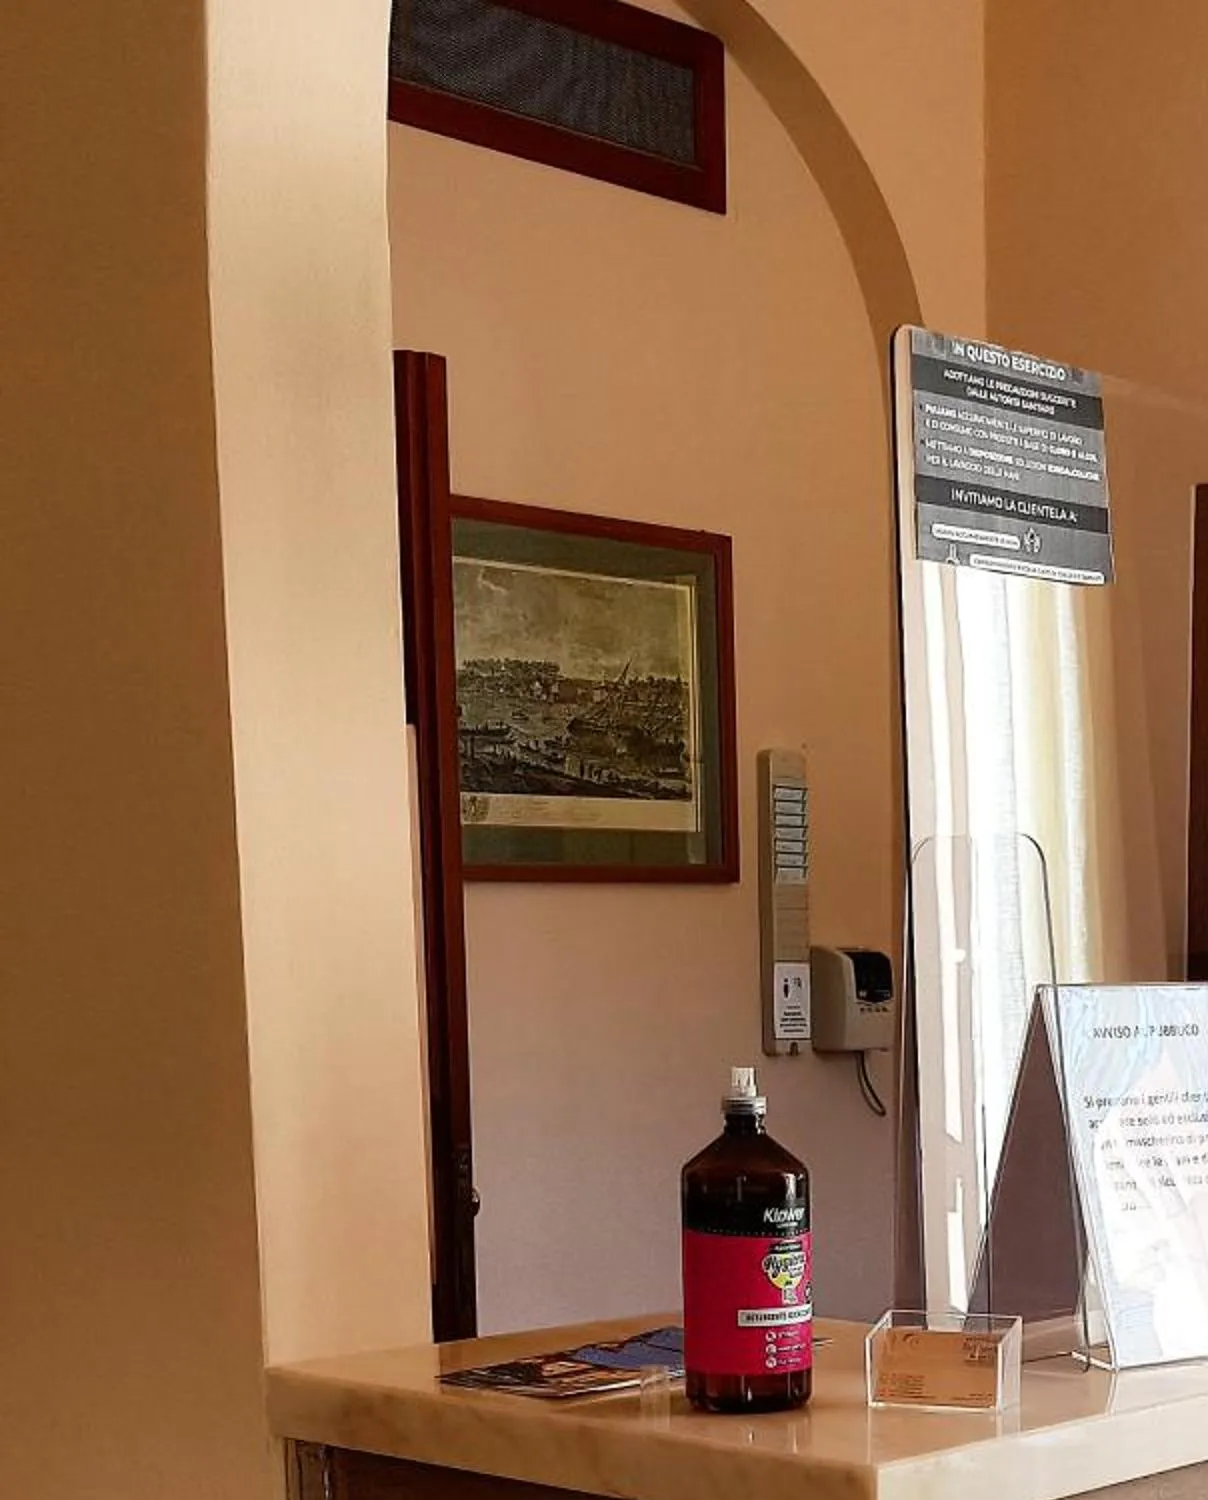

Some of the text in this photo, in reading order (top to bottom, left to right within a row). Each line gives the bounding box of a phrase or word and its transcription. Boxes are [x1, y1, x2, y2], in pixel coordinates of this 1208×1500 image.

[966, 344, 1010, 369] QUESTO
[1011, 355, 1067, 381] ESERCIZIO
[1004, 498, 1017, 512] LA
